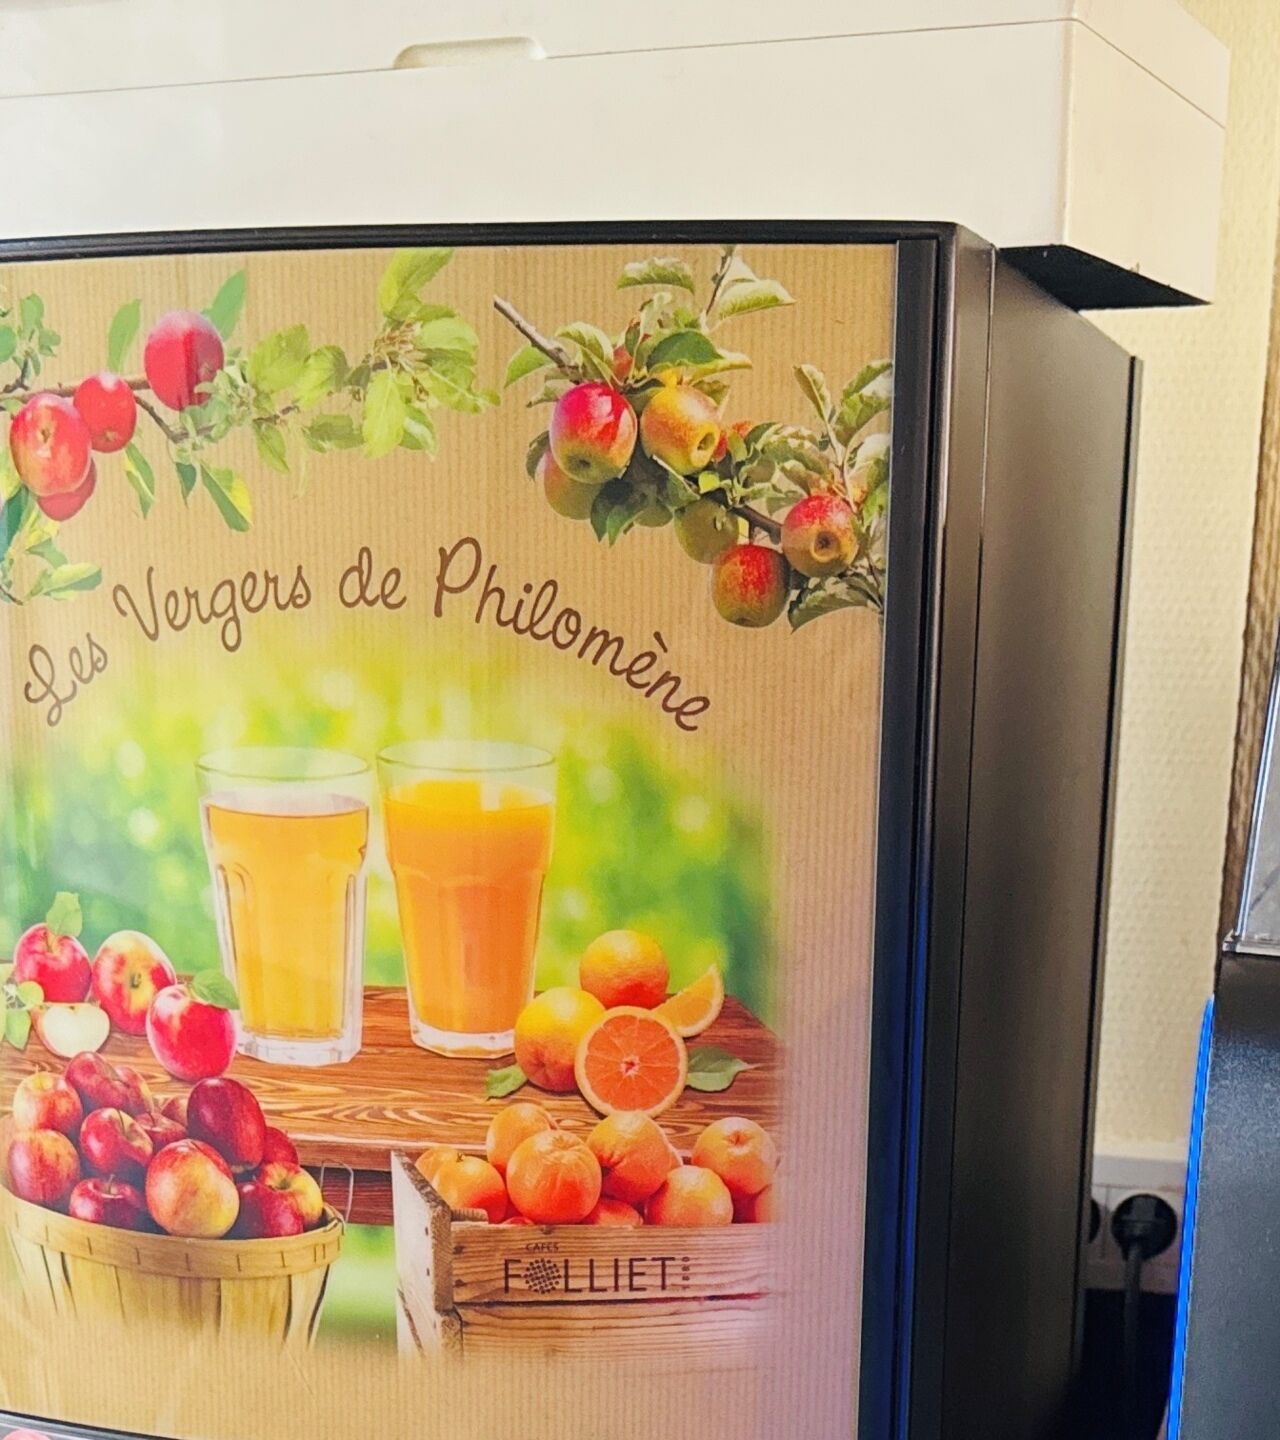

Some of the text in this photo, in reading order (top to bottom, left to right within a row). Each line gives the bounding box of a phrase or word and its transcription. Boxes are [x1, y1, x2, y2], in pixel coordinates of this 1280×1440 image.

[24, 537, 711, 733] Les Vergers de Philomène
[504, 1257, 676, 1294] FOLLIET
